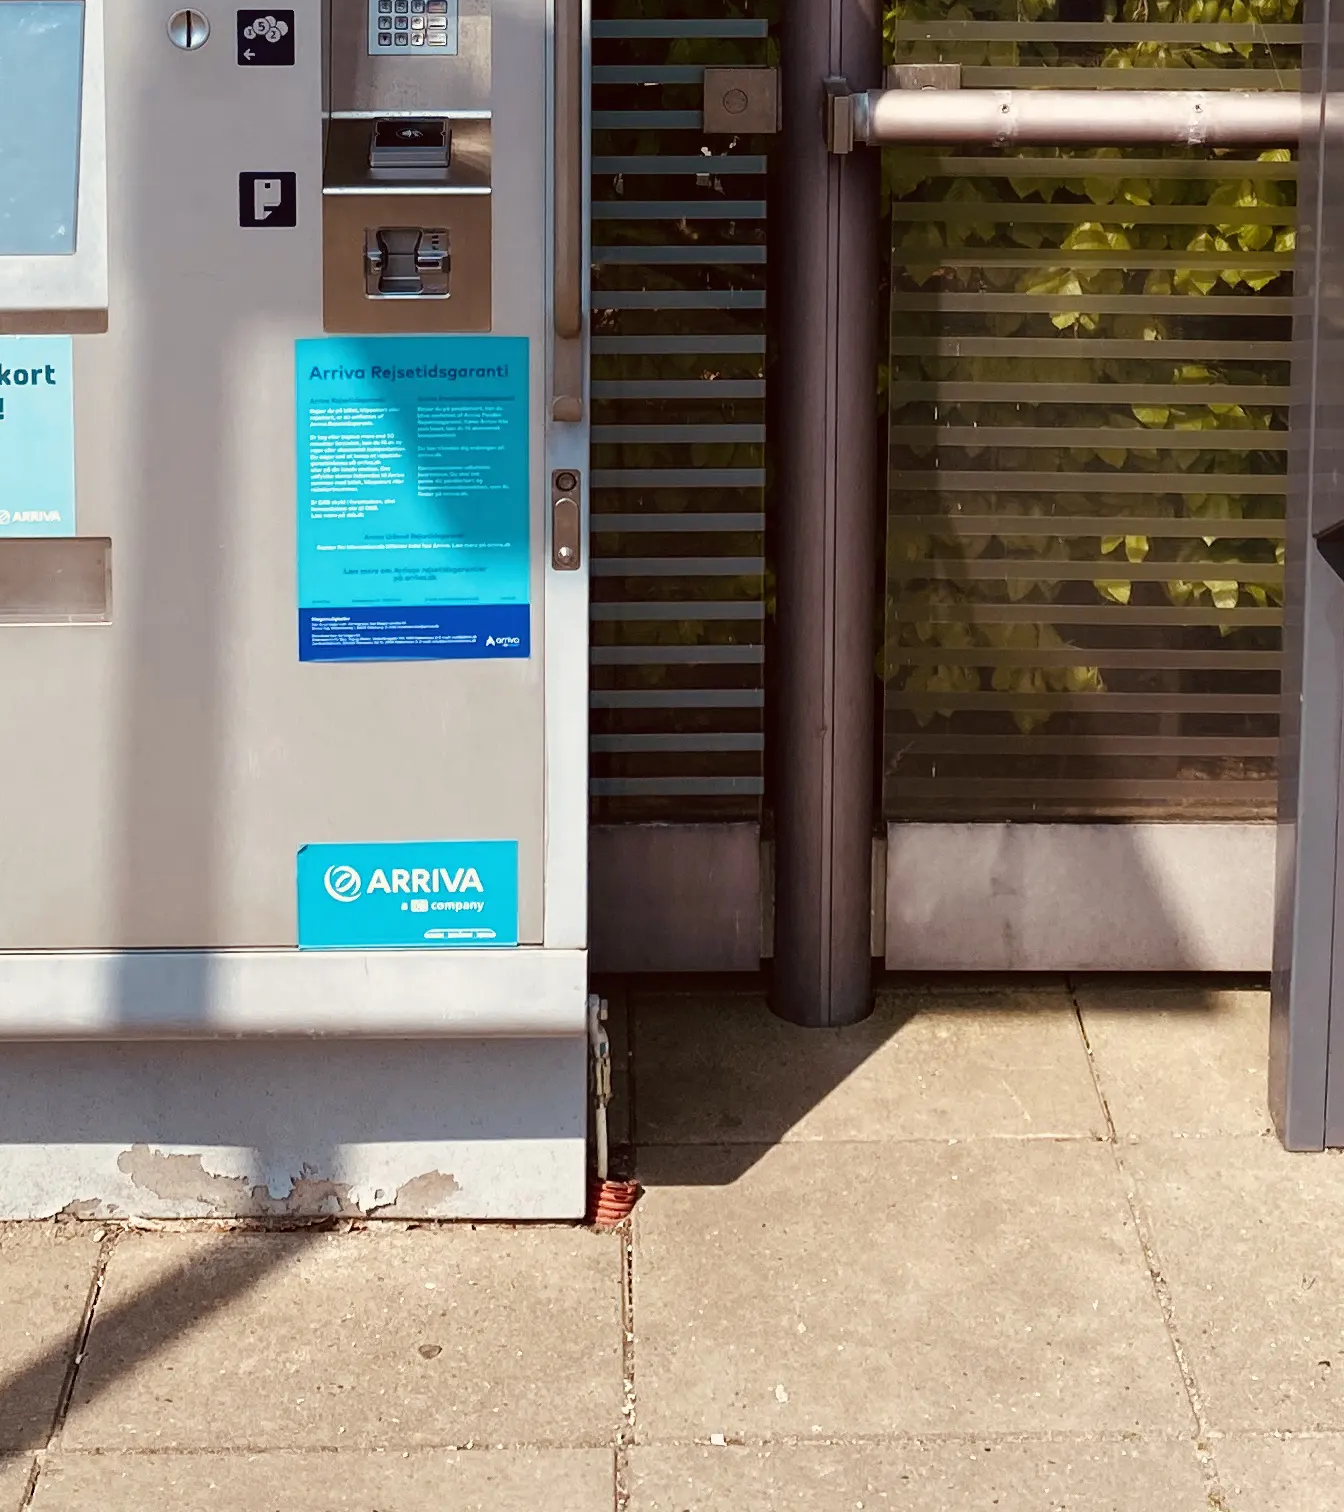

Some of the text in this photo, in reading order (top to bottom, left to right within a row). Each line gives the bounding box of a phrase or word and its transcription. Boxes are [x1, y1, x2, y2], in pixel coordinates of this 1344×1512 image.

[258, 21, 266, 32] 5
[270, 31, 277, 40] 2
[309, 364, 510, 382] Arriva Rejsetidsgaranti
[11, 509, 61, 523] ARRIVA
[496, 637, 520, 645] arriva
[366, 867, 485, 894] ARRIVA
[401, 903, 408, 911] a
[430, 900, 485, 912] company
